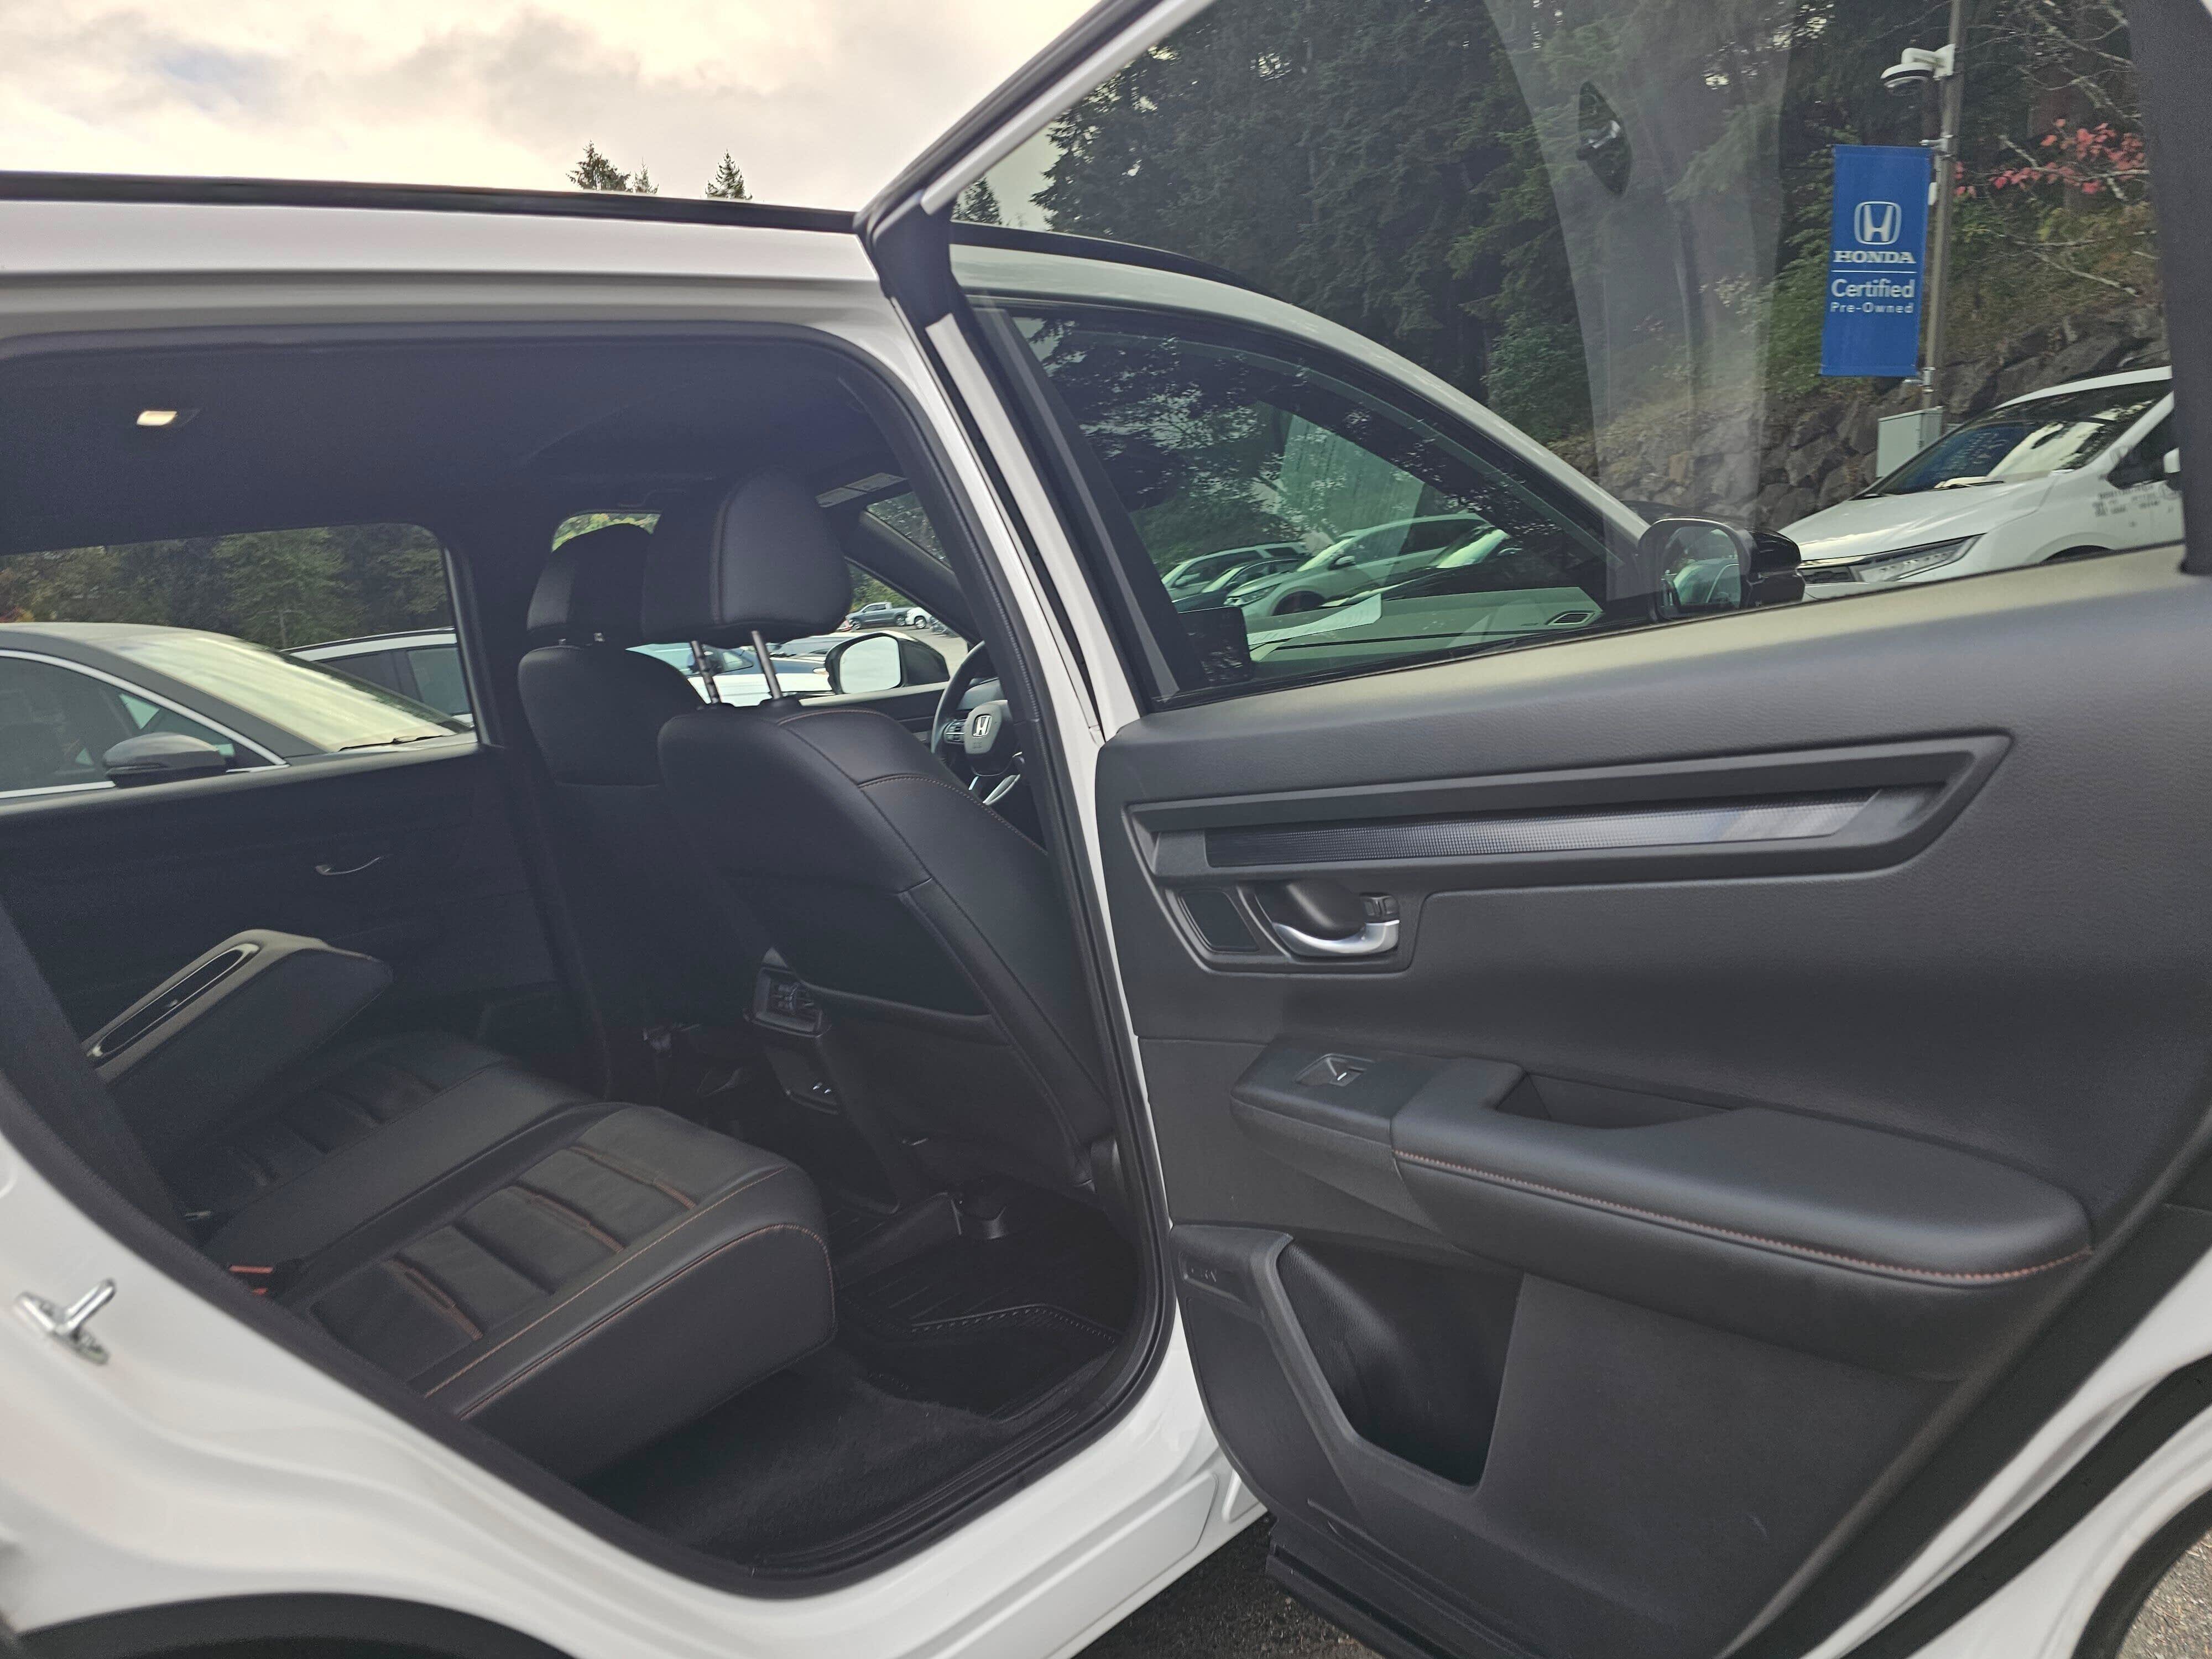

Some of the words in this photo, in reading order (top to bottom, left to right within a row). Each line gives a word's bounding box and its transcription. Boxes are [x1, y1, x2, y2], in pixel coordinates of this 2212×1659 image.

[1833, 251, 1916, 264] HONDA
[1831, 278, 1915, 298] Certified
[1830, 302, 1913, 314] Pre-Owned
